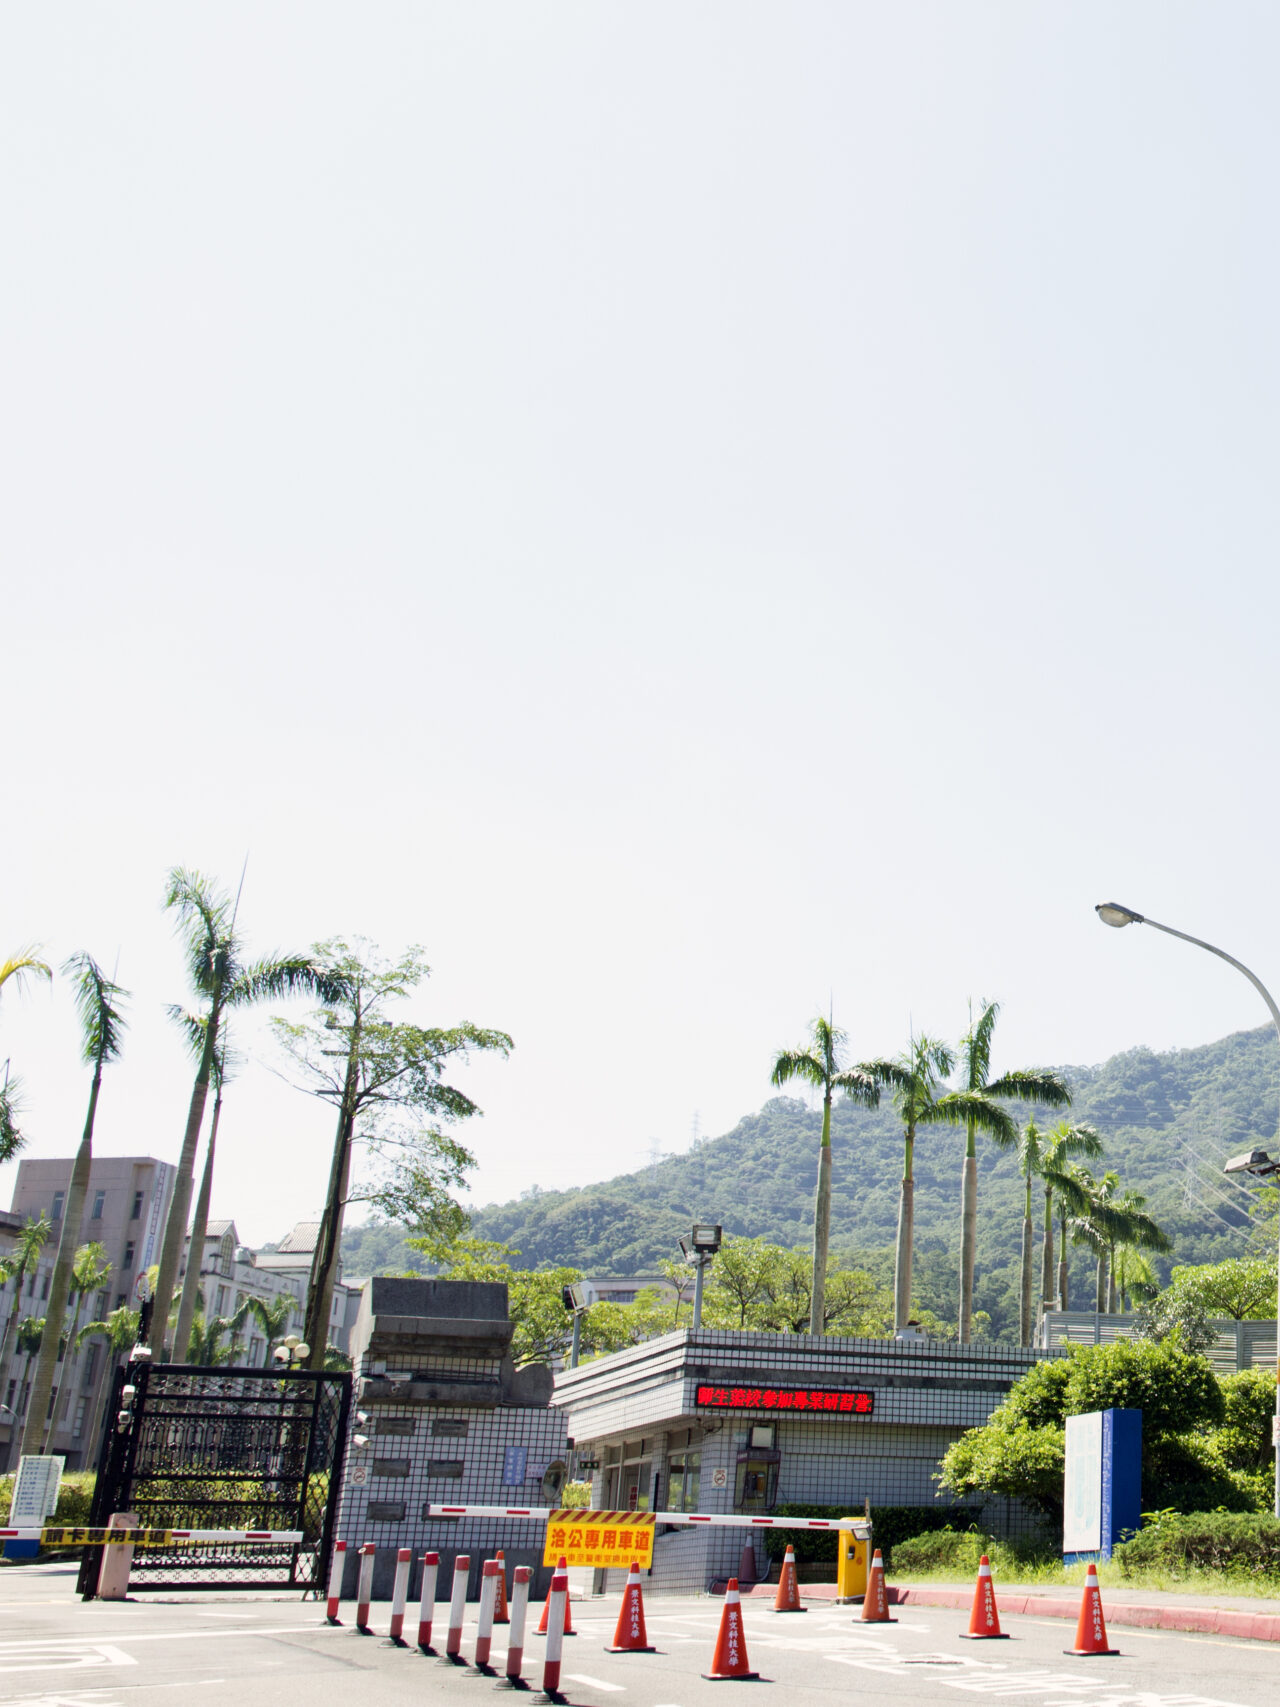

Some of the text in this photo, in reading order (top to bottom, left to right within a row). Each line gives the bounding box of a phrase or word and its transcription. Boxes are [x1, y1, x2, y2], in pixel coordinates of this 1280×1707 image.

[550, 1527, 651, 1551] 洽公專用車道
[728, 1611, 739, 1667] 景文科技大學
